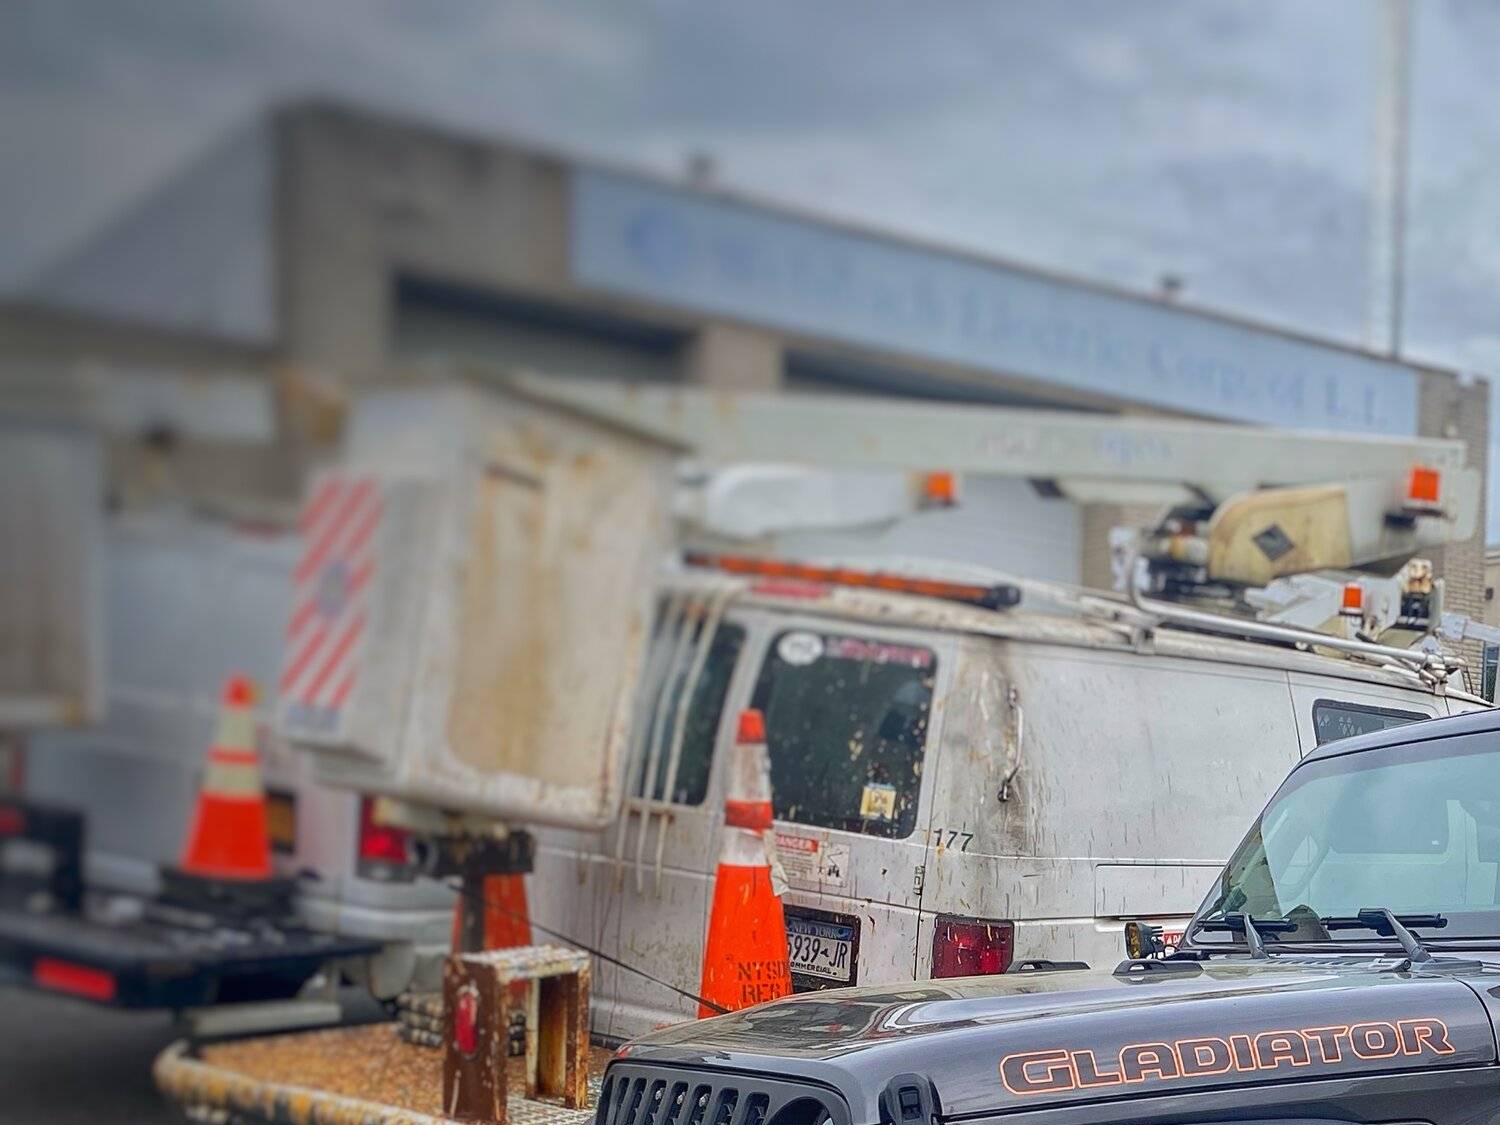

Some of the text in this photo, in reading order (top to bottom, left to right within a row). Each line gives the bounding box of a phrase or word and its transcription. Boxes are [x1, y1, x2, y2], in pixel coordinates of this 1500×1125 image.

[776, 836, 812, 851] ANGER
[933, 828, 974, 852] 177
[829, 942, 848, 968] JR
[790, 962, 832, 974] OMMERCIAL
[1000, 1018, 1456, 1096] GLADIATOR
